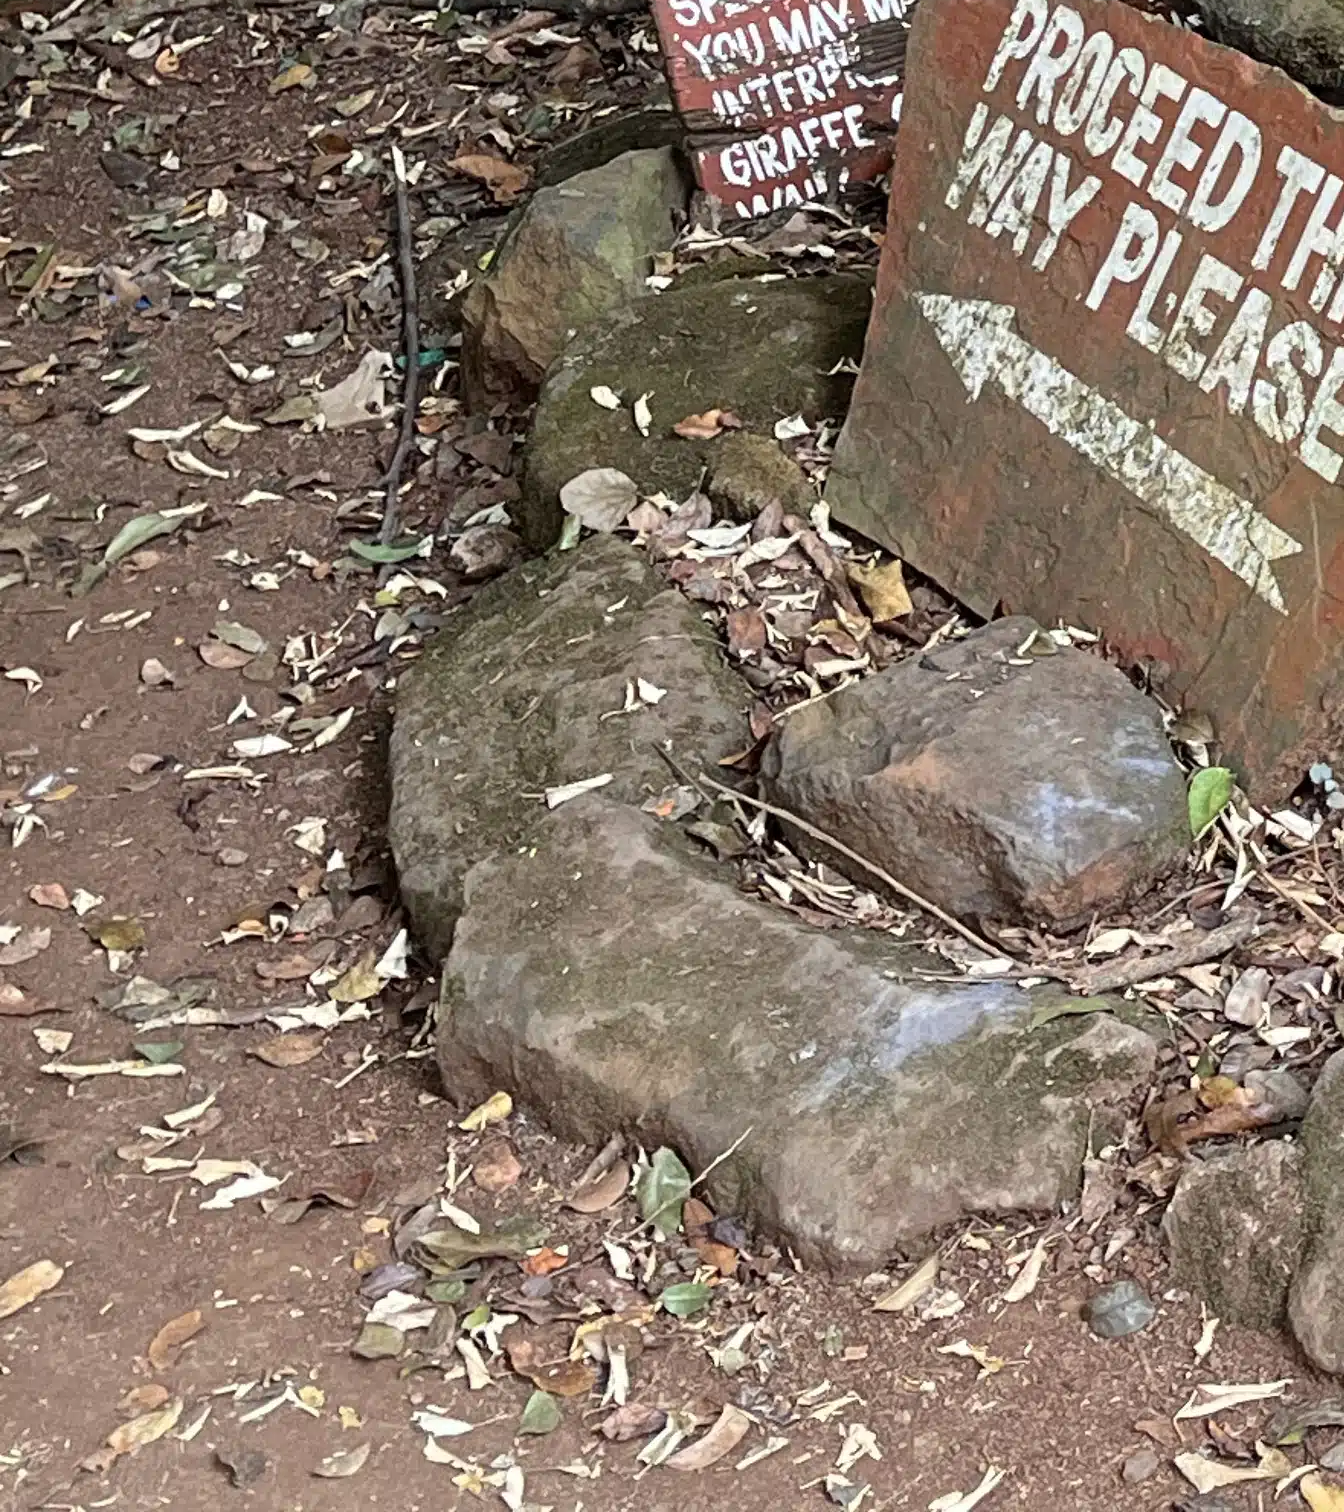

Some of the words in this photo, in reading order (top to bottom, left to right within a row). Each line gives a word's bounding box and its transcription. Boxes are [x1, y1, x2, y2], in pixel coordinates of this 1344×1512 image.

[681, 23, 764, 81] YOU
[719, 103, 875, 188] GIRAFFE
[944, 101, 1102, 272] WAY
